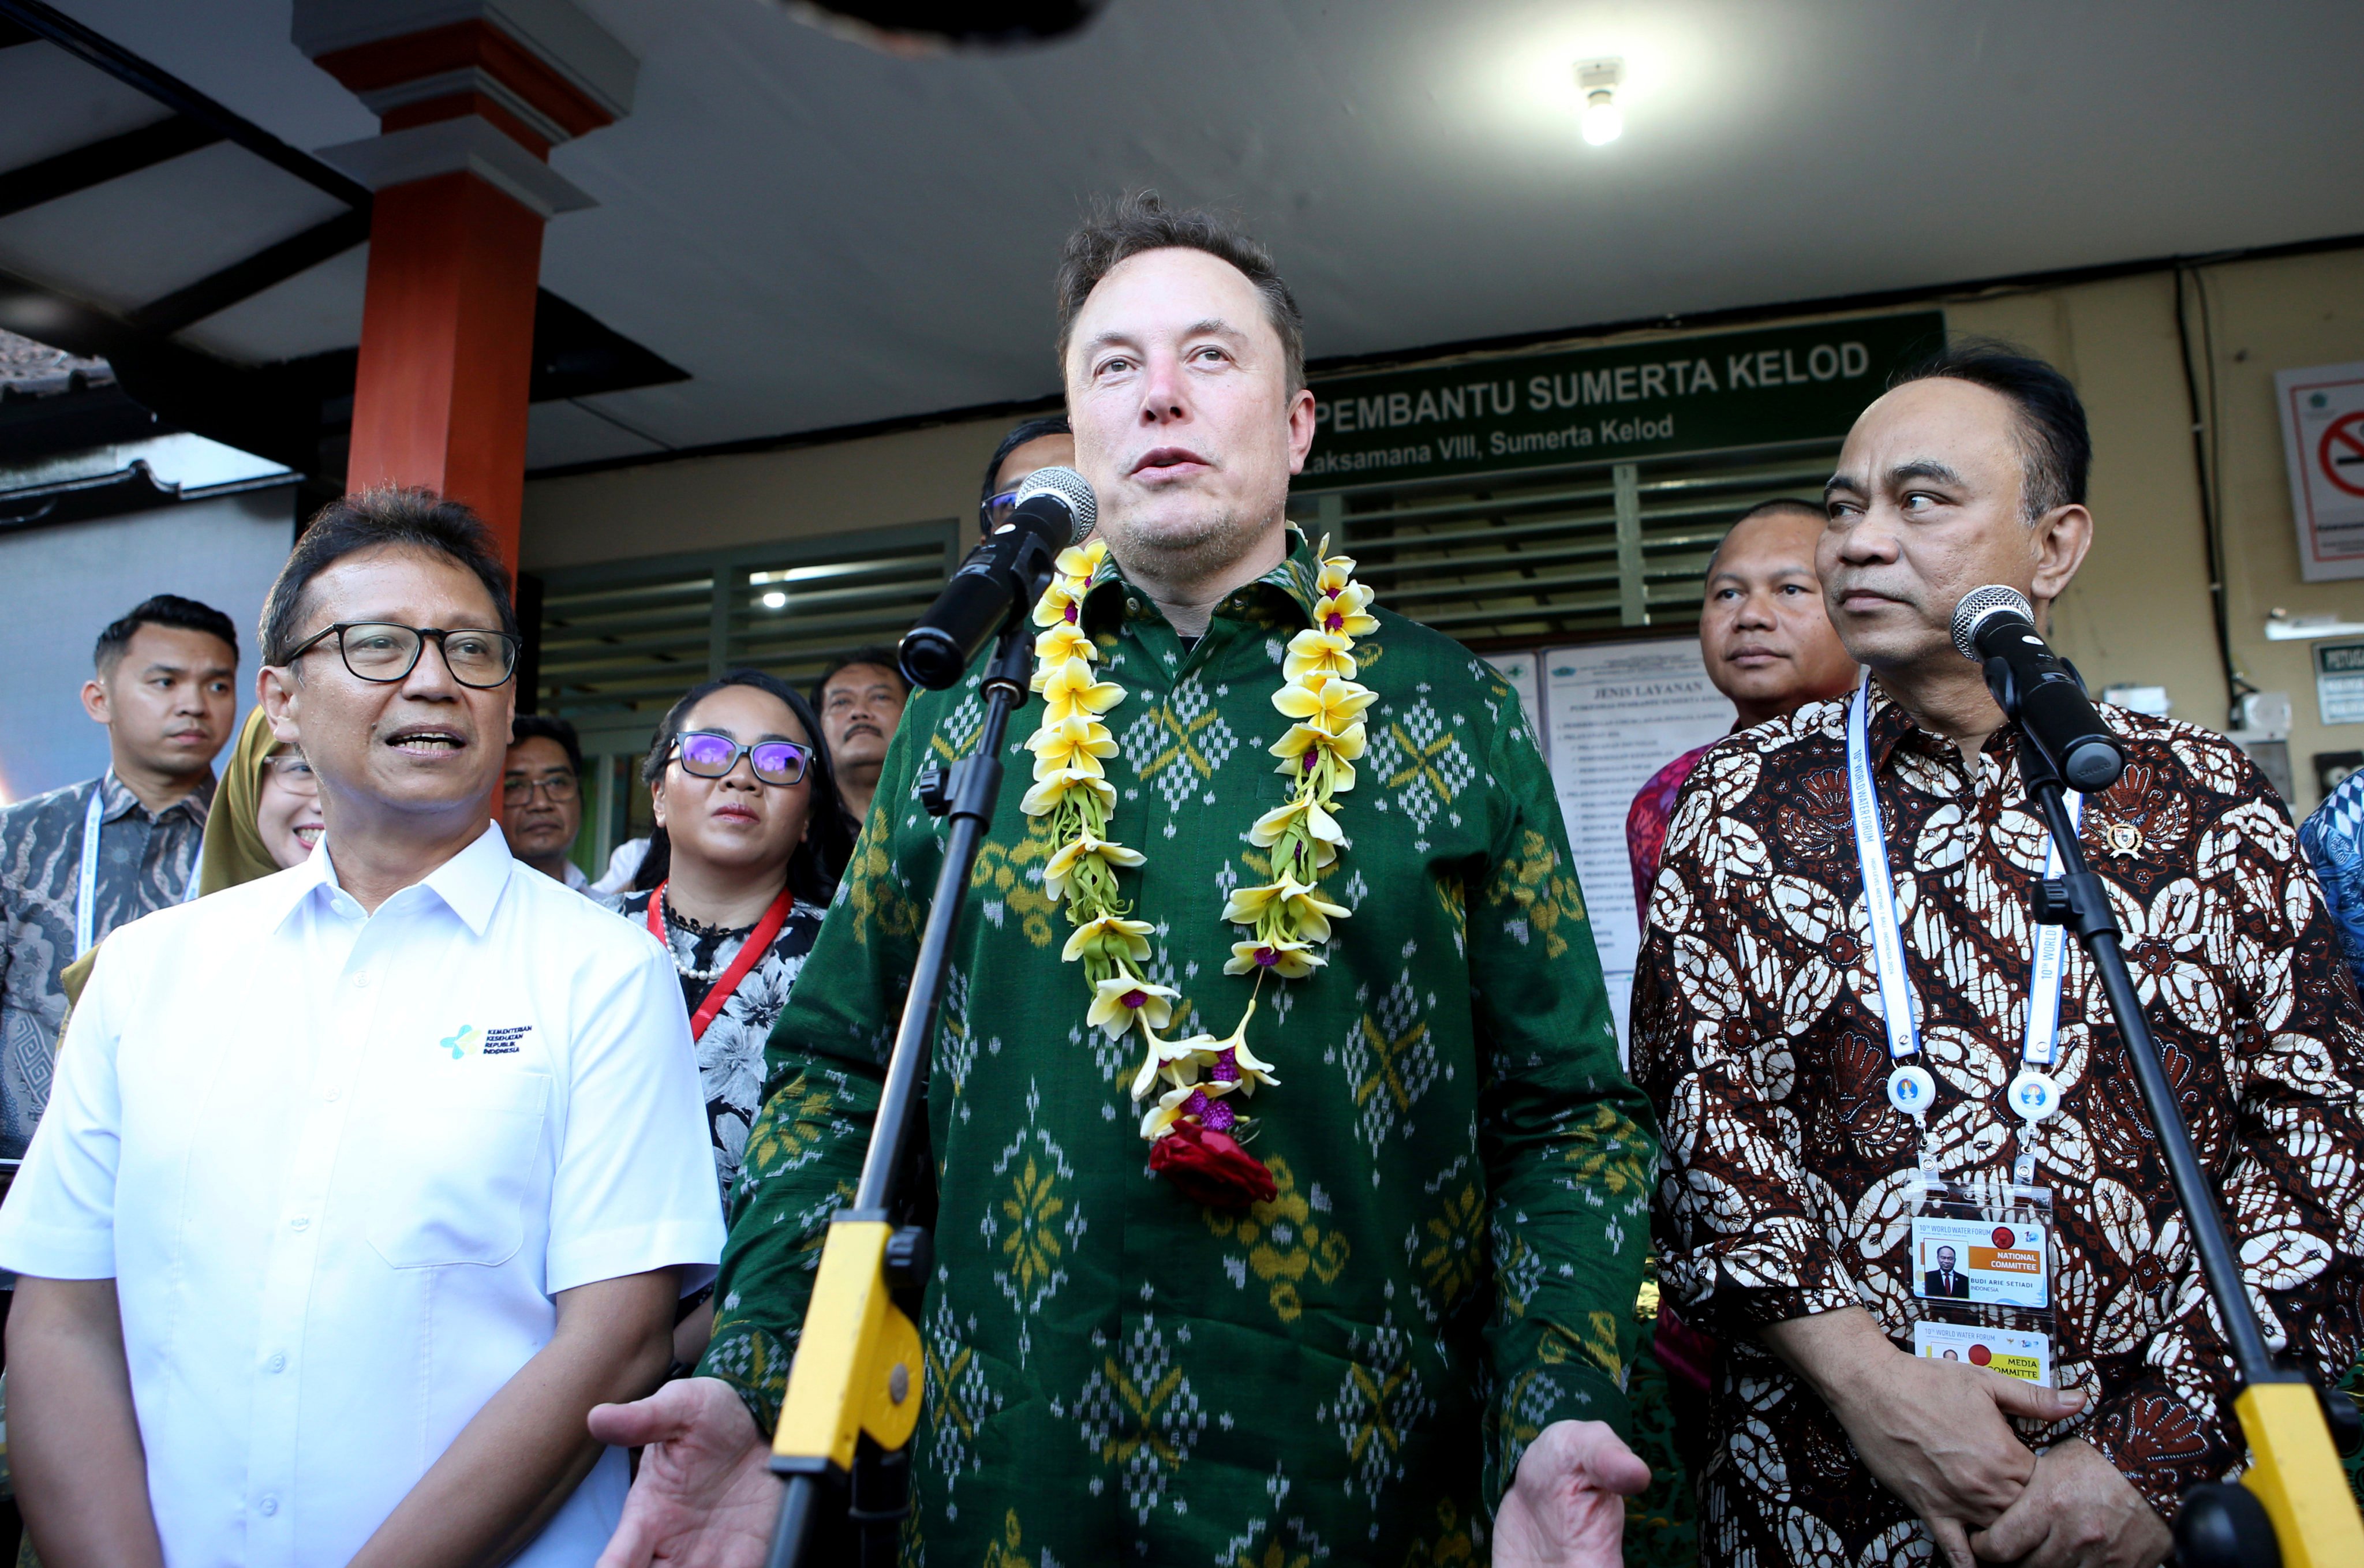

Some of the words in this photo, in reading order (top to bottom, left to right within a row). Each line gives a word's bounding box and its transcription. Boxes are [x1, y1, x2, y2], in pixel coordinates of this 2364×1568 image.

[1529, 358, 1719, 410] SUMERTA
[1727, 341, 1869, 390] KELOD
[1301, 444, 1432, 475] aksamana
[1438, 434, 1482, 459] VIII,
[1490, 425, 1593, 455] Sumerta
[1600, 413, 1673, 444] Kelod
[1594, 687, 1632, 699] JENIS
[1634, 680, 1703, 697] LAYANAN
[1854, 763, 1866, 790] WORLD
[1857, 789, 1871, 816] WATER
[1860, 814, 1875, 843] FORUM
[1875, 887, 1884, 910] MEETING
[1883, 931, 1892, 960] INDONESIA
[2043, 929, 2057, 960] WORLD
[2041, 963, 2052, 979] 10TH
[1931, 1225, 1951, 1233] WORLD
[1972, 1228, 1991, 1236] FORUM
[1991, 1260, 2037, 1271] COMMITTEE
[1998, 1252, 2036, 1262] NATIONAL
[1936, 1329, 1955, 1337] WORLD
[1988, 1366, 2037, 1378] OMMITTE
[2008, 1358, 2037, 1368] MEDIA
